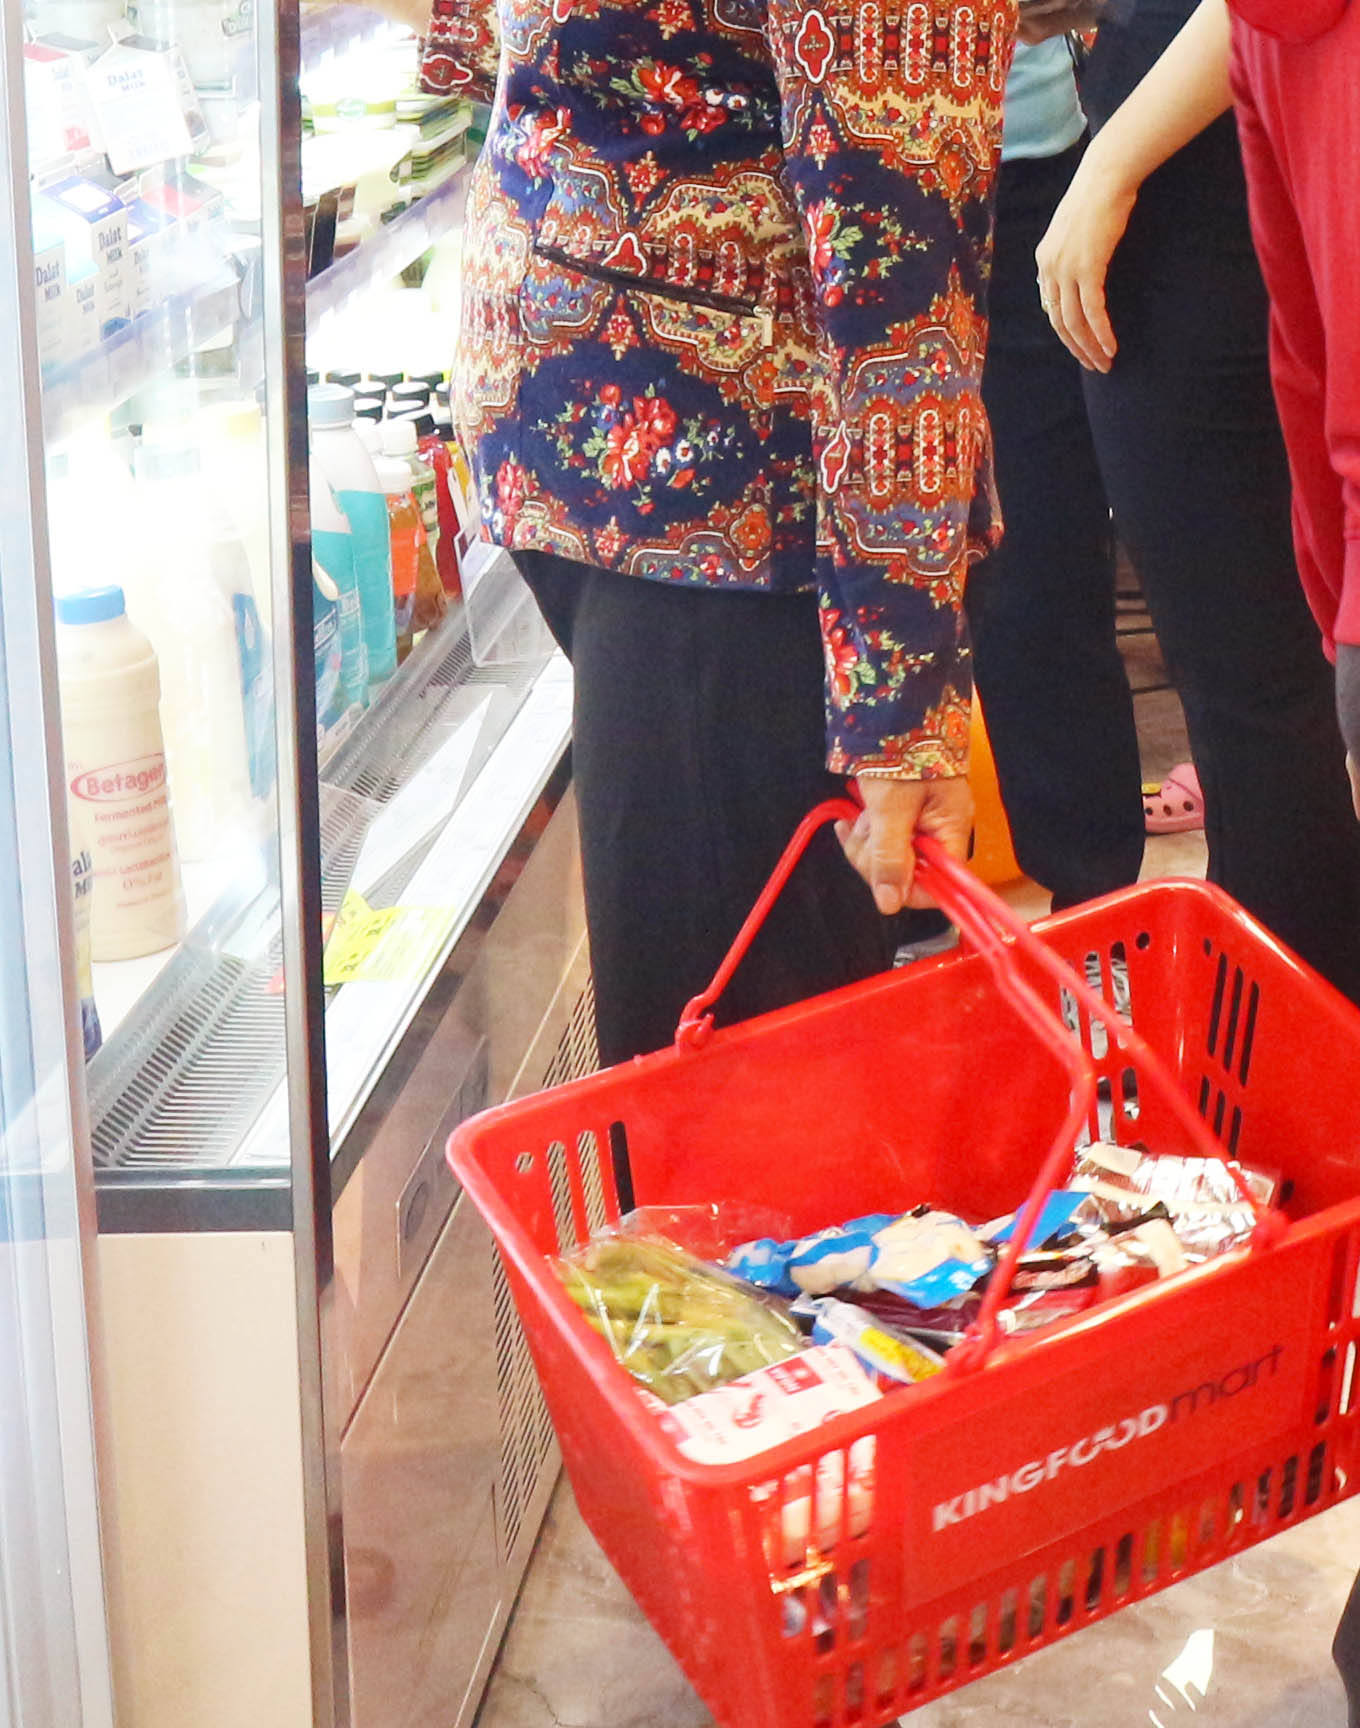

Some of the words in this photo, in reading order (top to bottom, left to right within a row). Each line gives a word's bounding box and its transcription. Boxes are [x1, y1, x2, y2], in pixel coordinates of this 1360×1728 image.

[106, 69, 144, 89] Dalat
[98, 225, 123, 252] Dalat
[106, 245, 124, 266] MILK
[36, 261, 62, 288] Dalat
[44, 285, 62, 304] MILK
[75, 283, 96, 305] Dalat
